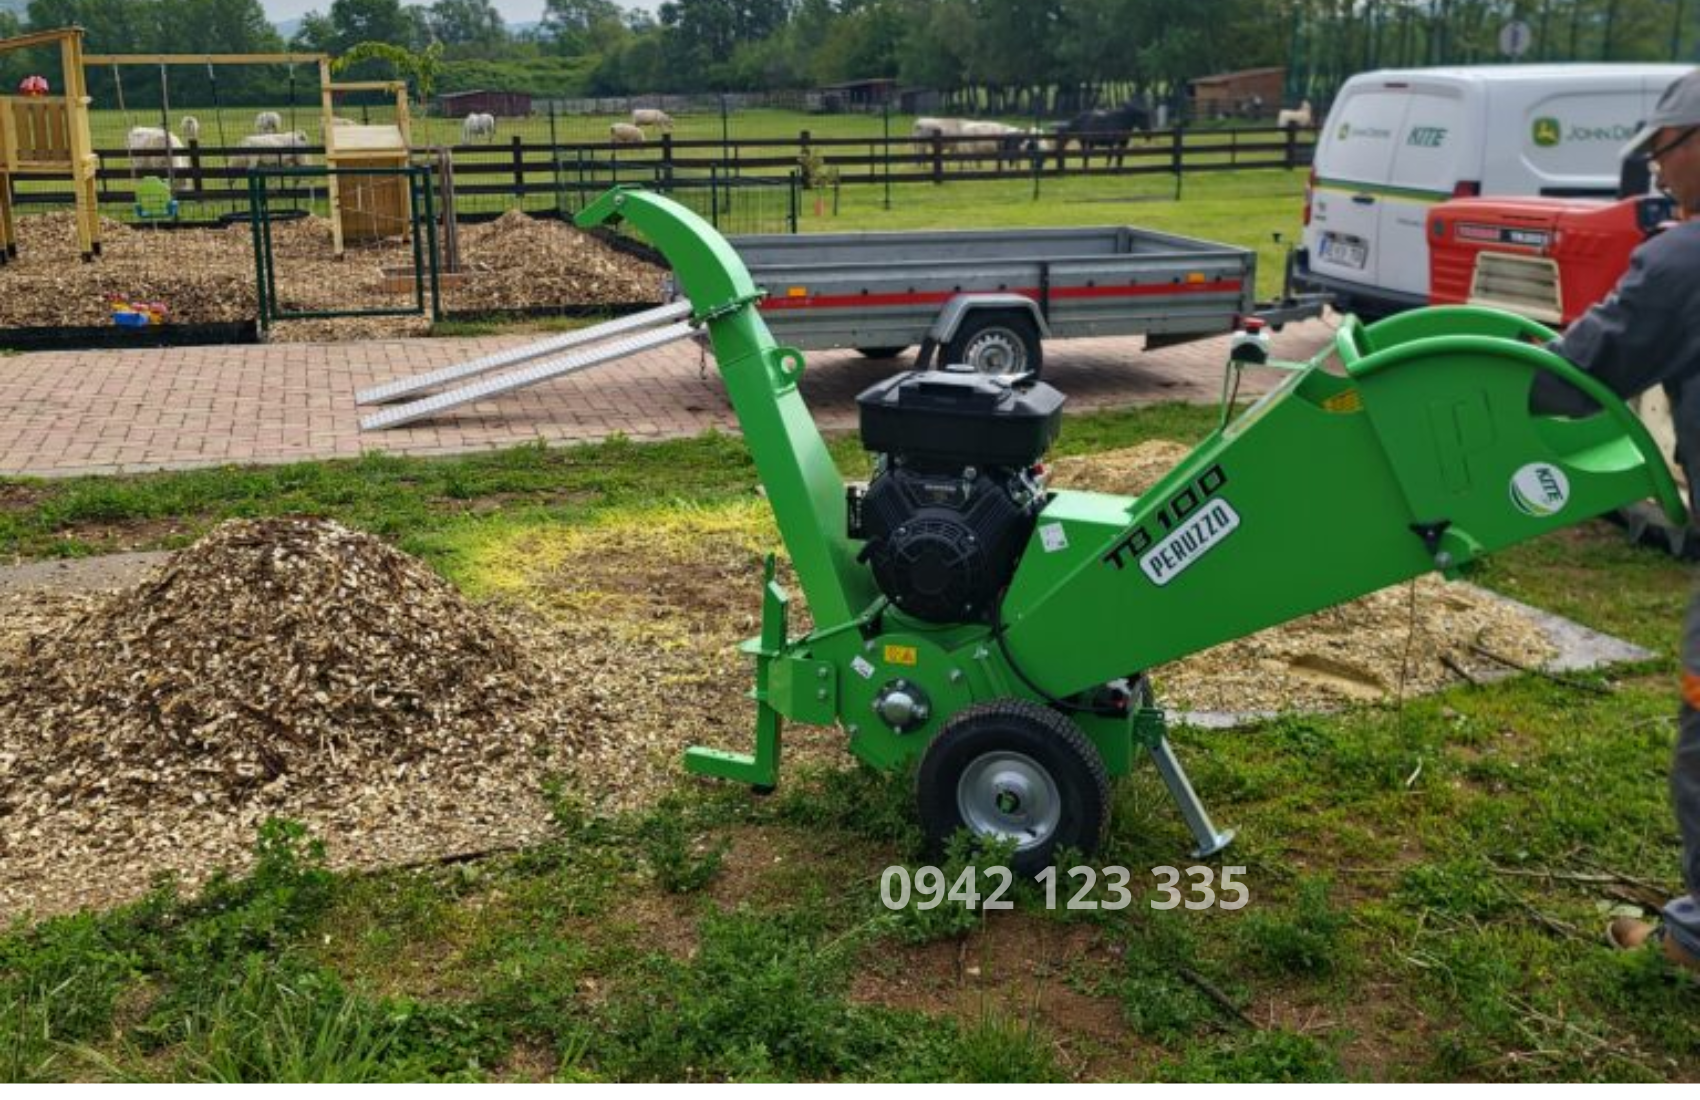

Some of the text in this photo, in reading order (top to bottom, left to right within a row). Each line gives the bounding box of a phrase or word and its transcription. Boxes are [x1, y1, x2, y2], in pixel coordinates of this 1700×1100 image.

[1406, 126, 1448, 148] KITE
[1535, 468, 1563, 502] KITE
[1103, 526, 1152, 570] TB
[1157, 464, 1227, 530] 100
[1149, 505, 1230, 577] PERUZZO
